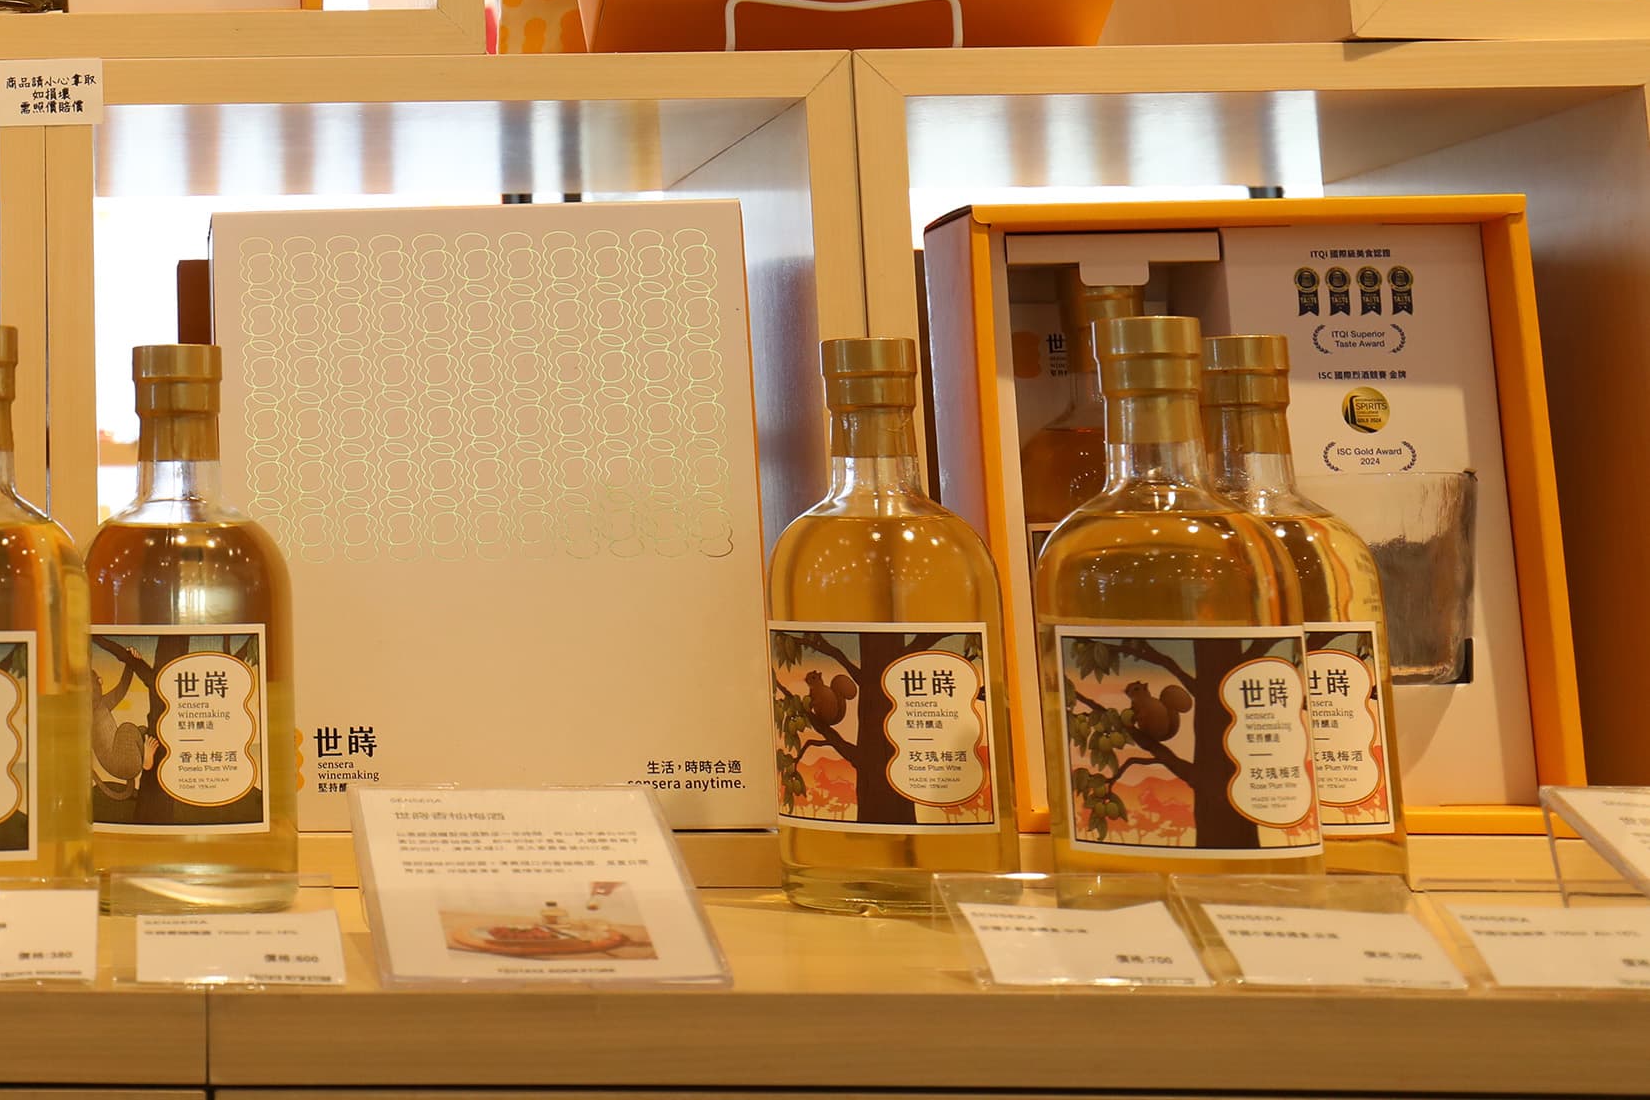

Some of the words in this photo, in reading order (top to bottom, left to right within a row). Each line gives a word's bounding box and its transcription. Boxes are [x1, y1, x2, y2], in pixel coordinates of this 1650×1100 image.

[6, 74, 96, 89] 商品請小心拿取
[32, 88, 70, 100] 如損壞
[20, 100, 84, 114] 需照價賠償
[1310, 251, 1328, 259] ITQI
[1350, 330, 1385, 340] Superior
[1335, 340, 1356, 348] Taste
[1358, 340, 1385, 348] Award
[1354, 447, 1374, 455] Gold
[174, 670, 229, 699] 世嵵
[901, 669, 956, 698] 世嵵
[1239, 679, 1288, 708] 世嵵
[178, 701, 210, 709] sensera
[906, 700, 938, 708] sensera
[178, 709, 230, 720] winemaking
[906, 709, 959, 719] winemaking
[1312, 709, 1354, 719] nemaking
[314, 726, 377, 758] 世嵵
[179, 751, 238, 764] 香柚梅酒
[909, 751, 967, 763] 玫瑰梅酒
[178, 764, 203, 772] Pomelo
[204, 764, 221, 772] Plum
[222, 764, 238, 772] Wine
[318, 760, 354, 770] sensera
[647, 760, 742, 774] 生活，時時合適
[908, 764, 926, 772] Rose
[928, 764, 945, 772] Plum
[946, 764, 962, 772] Wine
[318, 770, 380, 782] winemaking
[318, 782, 348, 793] 堅持釀
[685, 777, 746, 792] anytime.
